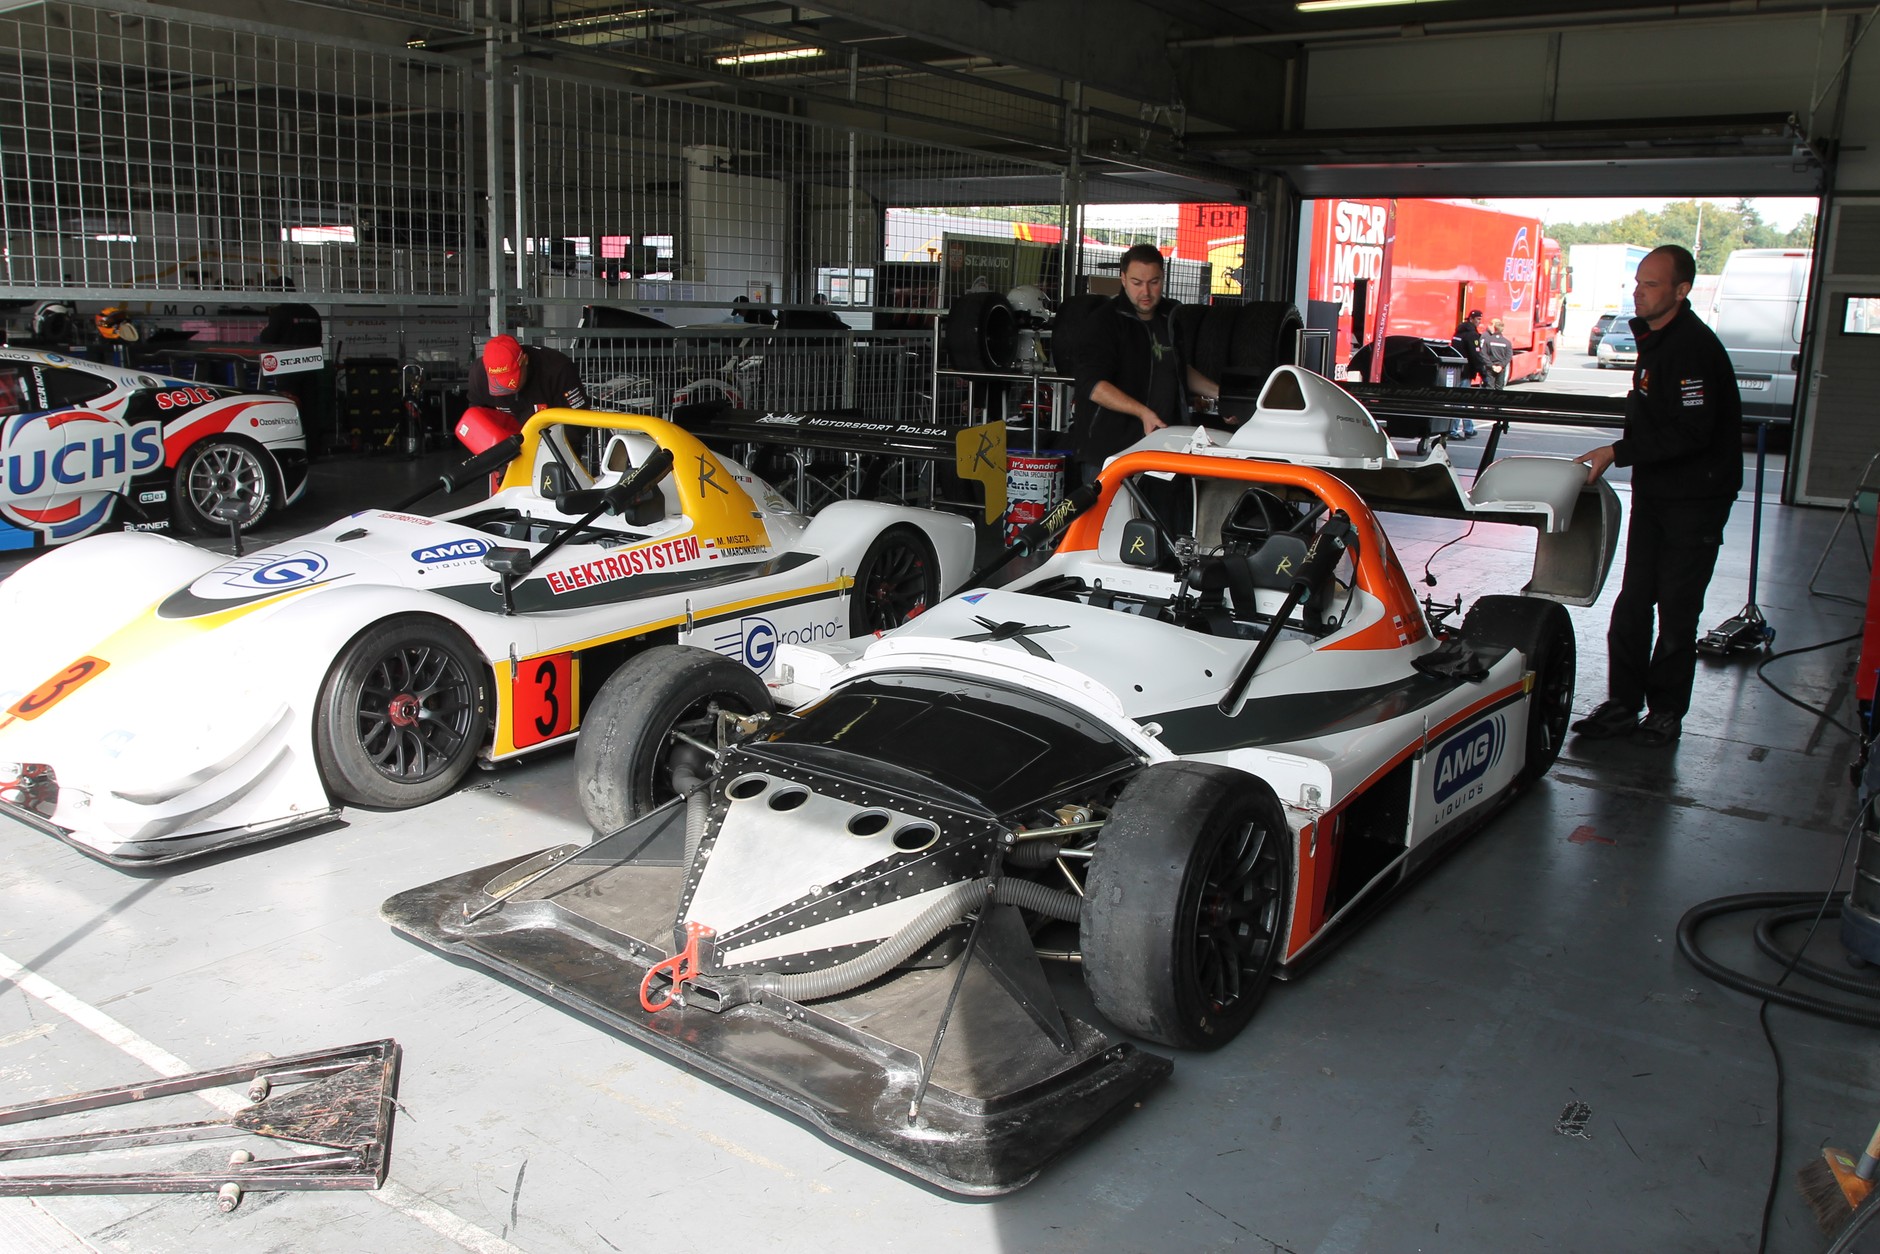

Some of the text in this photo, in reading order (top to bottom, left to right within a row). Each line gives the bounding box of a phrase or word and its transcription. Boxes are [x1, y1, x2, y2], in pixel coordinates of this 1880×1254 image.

[1195, 205, 1246, 227] Fer
[1335, 201, 1386, 244] STAR
[1333, 244, 1383, 284] MOTO
[1503, 257, 1534, 282] FUCHS
[280, 358, 301, 366] STAR
[302, 354, 323, 364] MOTO
[156, 387, 215, 410] selt
[259, 416, 298, 427] Ozoshi Racing
[0, 427, 160, 495] UCHS
[1012, 461, 1024, 469] It's
[420, 542, 481, 561] AMG
[726, 535, 750, 545] MISZTA
[427, 559, 484, 571] LIQUID
[547, 536, 701, 593] ELEKTROSYSTEM
[19, 661, 96, 713] 3
[534, 660, 559, 737] 3
[1437, 732, 1489, 791] AMG
[1434, 783, 1483, 825] LIQUIDS
